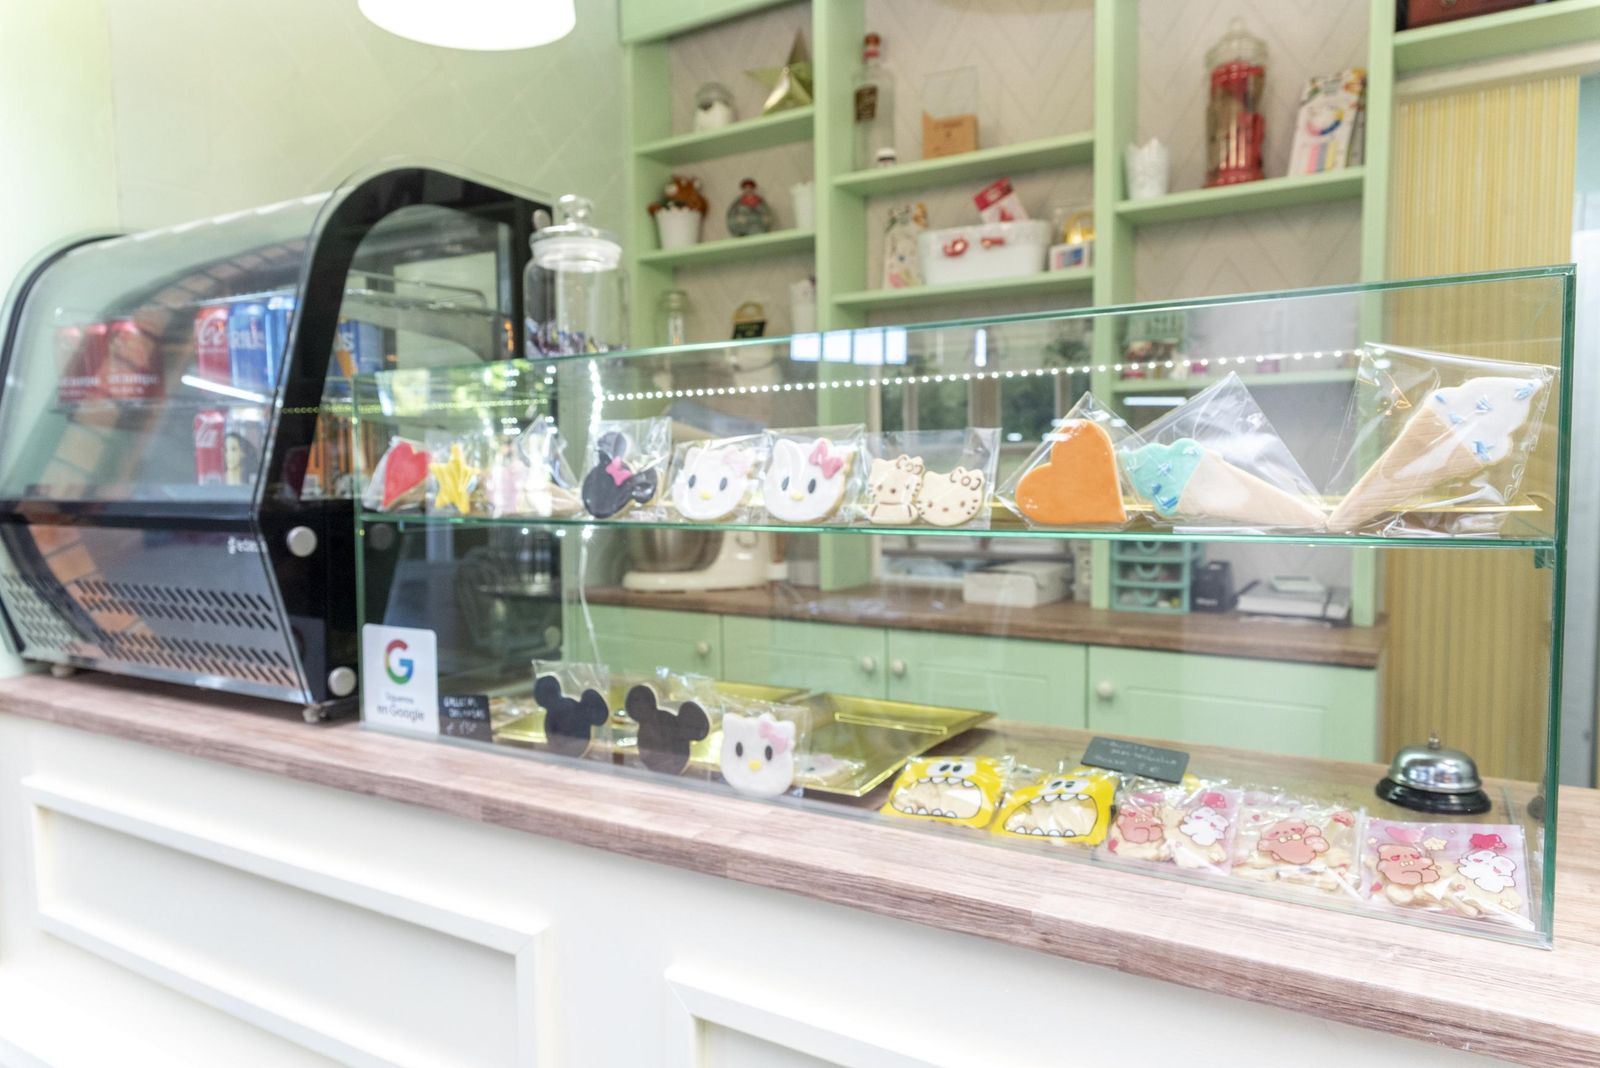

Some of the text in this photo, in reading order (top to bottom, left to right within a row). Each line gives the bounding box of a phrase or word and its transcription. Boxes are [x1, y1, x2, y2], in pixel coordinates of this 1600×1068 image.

[384, 639, 414, 685] G
[376, 703, 425, 723] en Google
